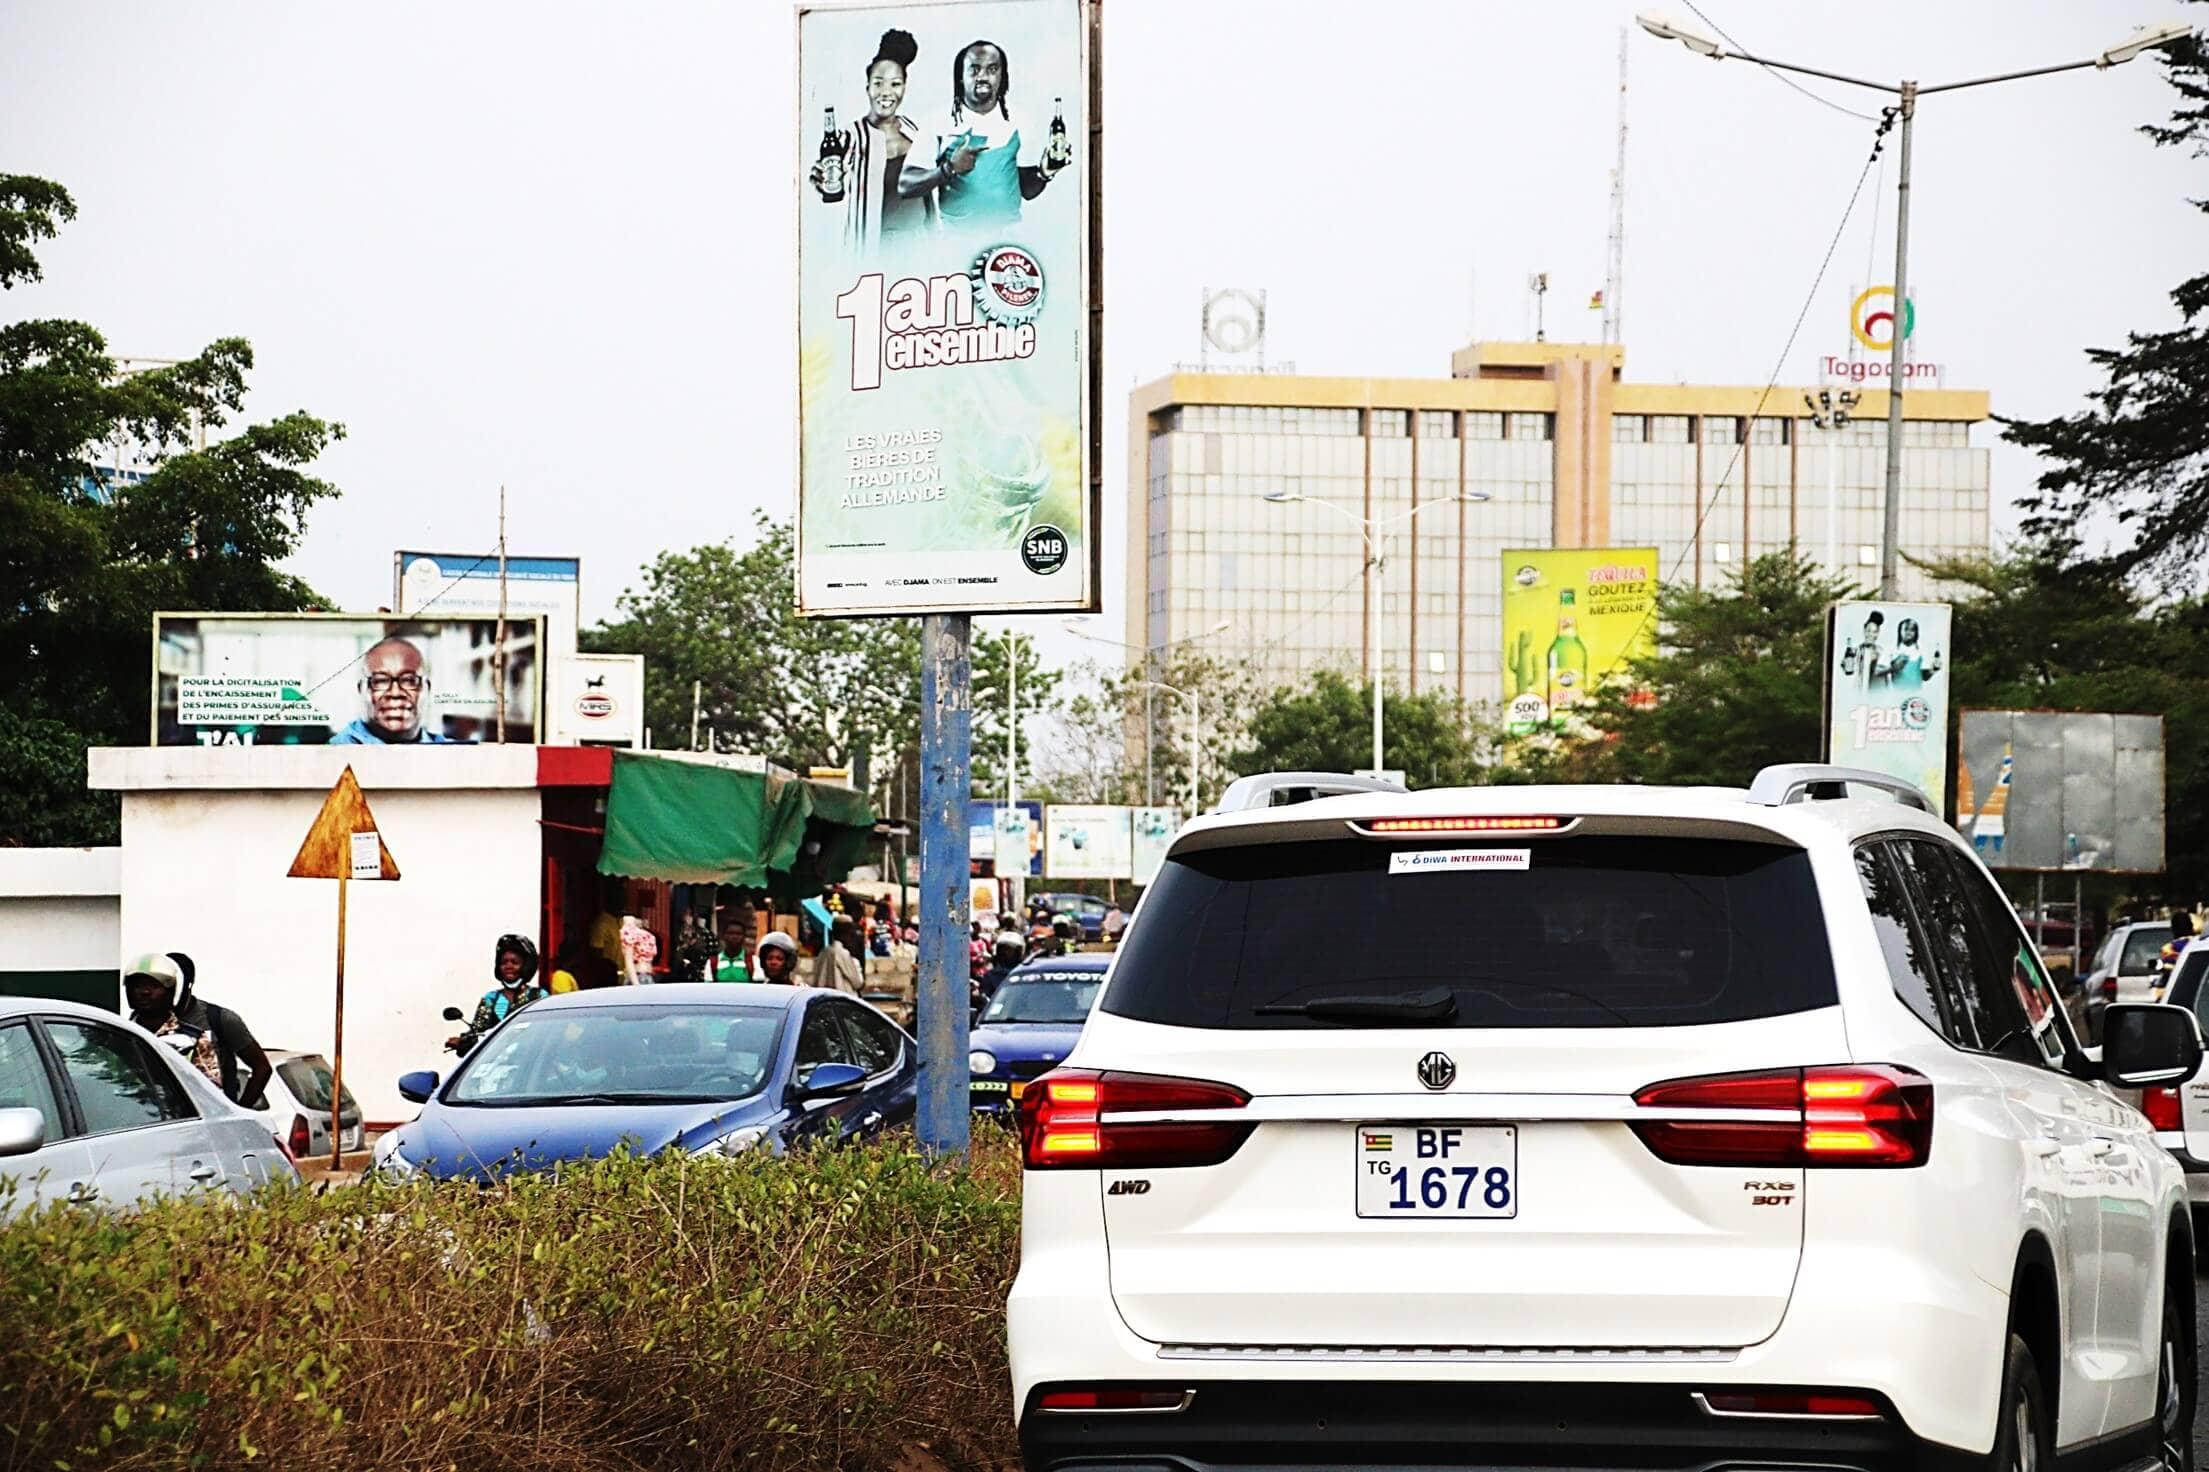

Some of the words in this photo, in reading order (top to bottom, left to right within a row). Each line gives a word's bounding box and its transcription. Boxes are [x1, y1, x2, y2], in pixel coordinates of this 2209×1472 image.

[836, 273, 884, 391] 1
[885, 272, 974, 333] an
[885, 321, 1036, 370] ensemble
[847, 435, 877, 452] LES
[880, 428, 943, 447] VRAIES
[913, 448, 937, 464] DE
[845, 466, 942, 489] TRADITION
[841, 485, 946, 509] ALLEMANDE
[1027, 540, 1062, 555] SNB
[885, 579, 901, 587] AVEC
[957, 577, 998, 585] ENSEMBLE
[1589, 603, 1645, 616] MEXIQUE
[227, 679, 302, 687] DIGITALISATION
[198, 690, 277, 698] L'ENCAISSEMENT
[1450, 855, 1525, 863] INTERNATIONAL
[1419, 1052, 1455, 1089] MG
[1416, 1129, 1462, 1158] BF
[1367, 1160, 1392, 1175] TG
[1107, 1180, 1151, 1195] AWD
[1389, 1166, 1511, 1209] 1678
[1752, 1195, 1796, 1206] 30T
